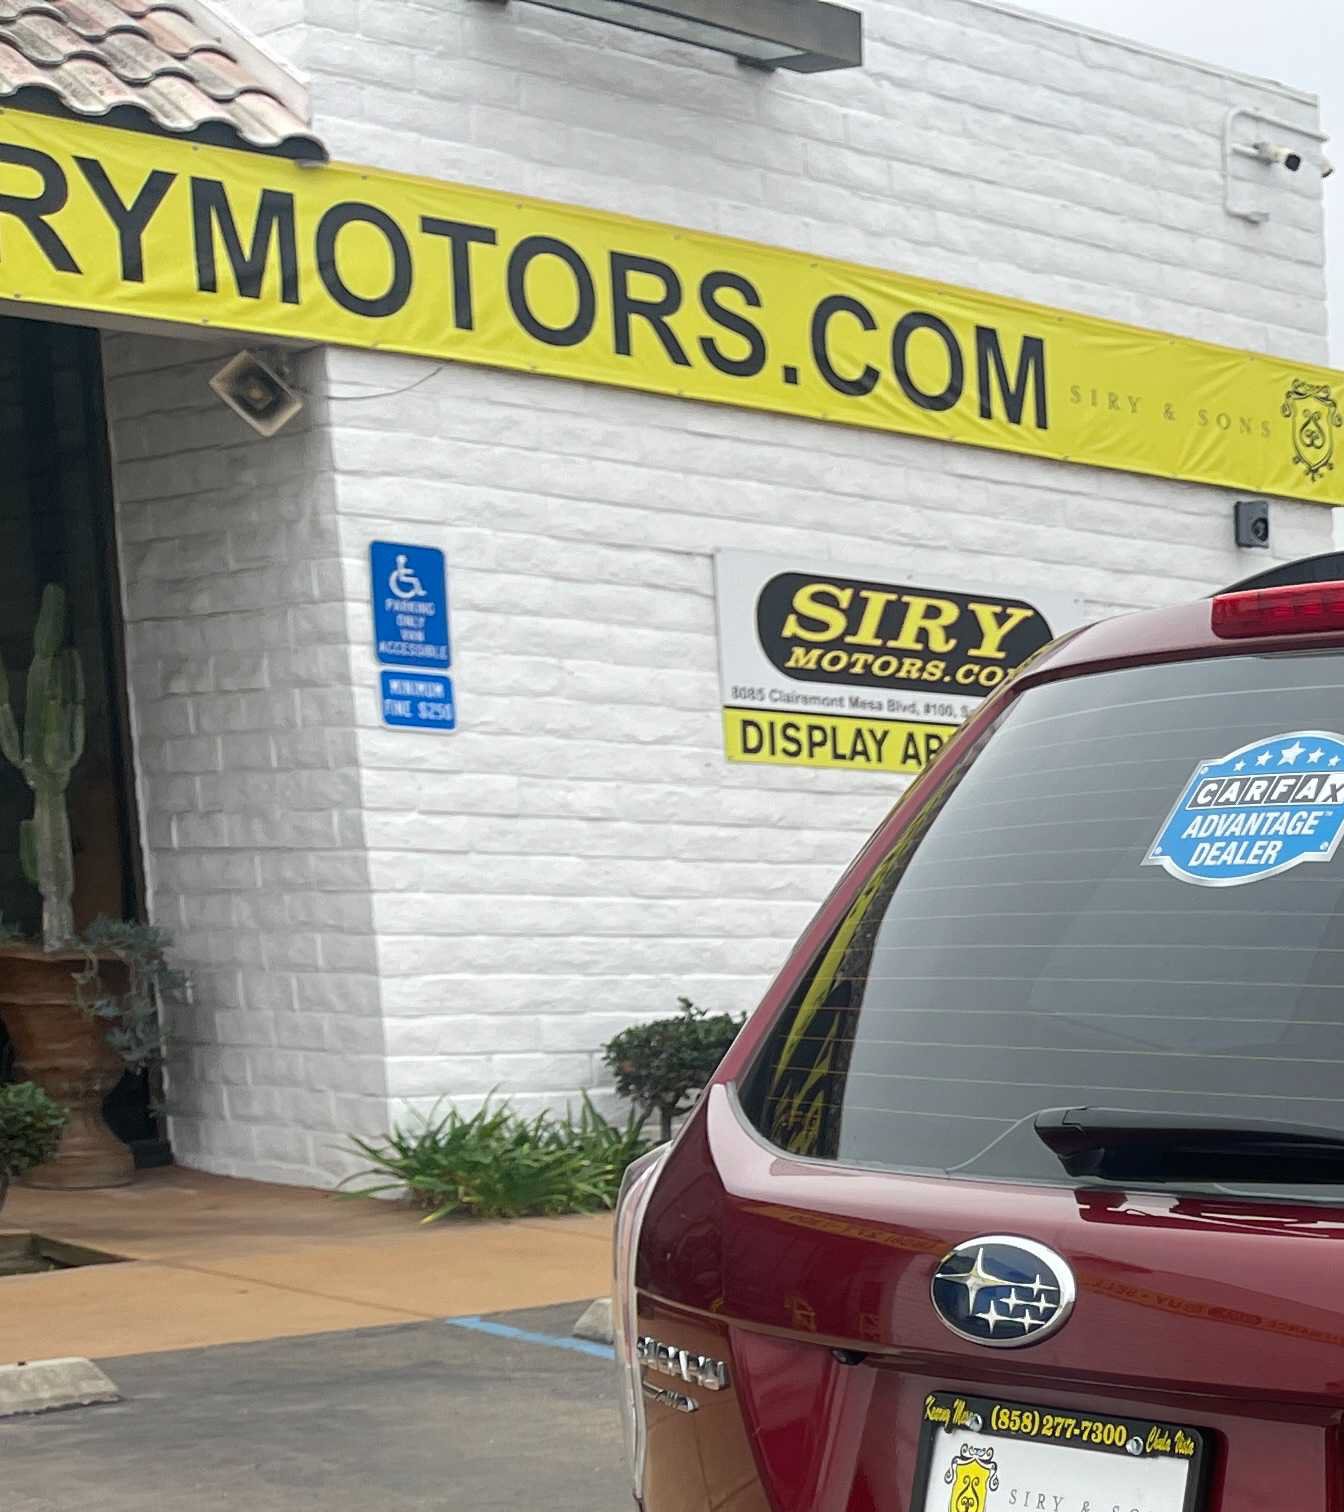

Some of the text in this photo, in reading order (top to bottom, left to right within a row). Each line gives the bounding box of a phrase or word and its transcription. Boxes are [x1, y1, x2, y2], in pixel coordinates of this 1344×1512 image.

[1070, 385, 1271, 438] SIRY & SONS
[781, 582, 1034, 658] SIRY
[739, 718, 945, 768] DISPLAY AR
[1188, 840, 1283, 867] DEALER
[1008, 1489, 1064, 1512] SIRY
